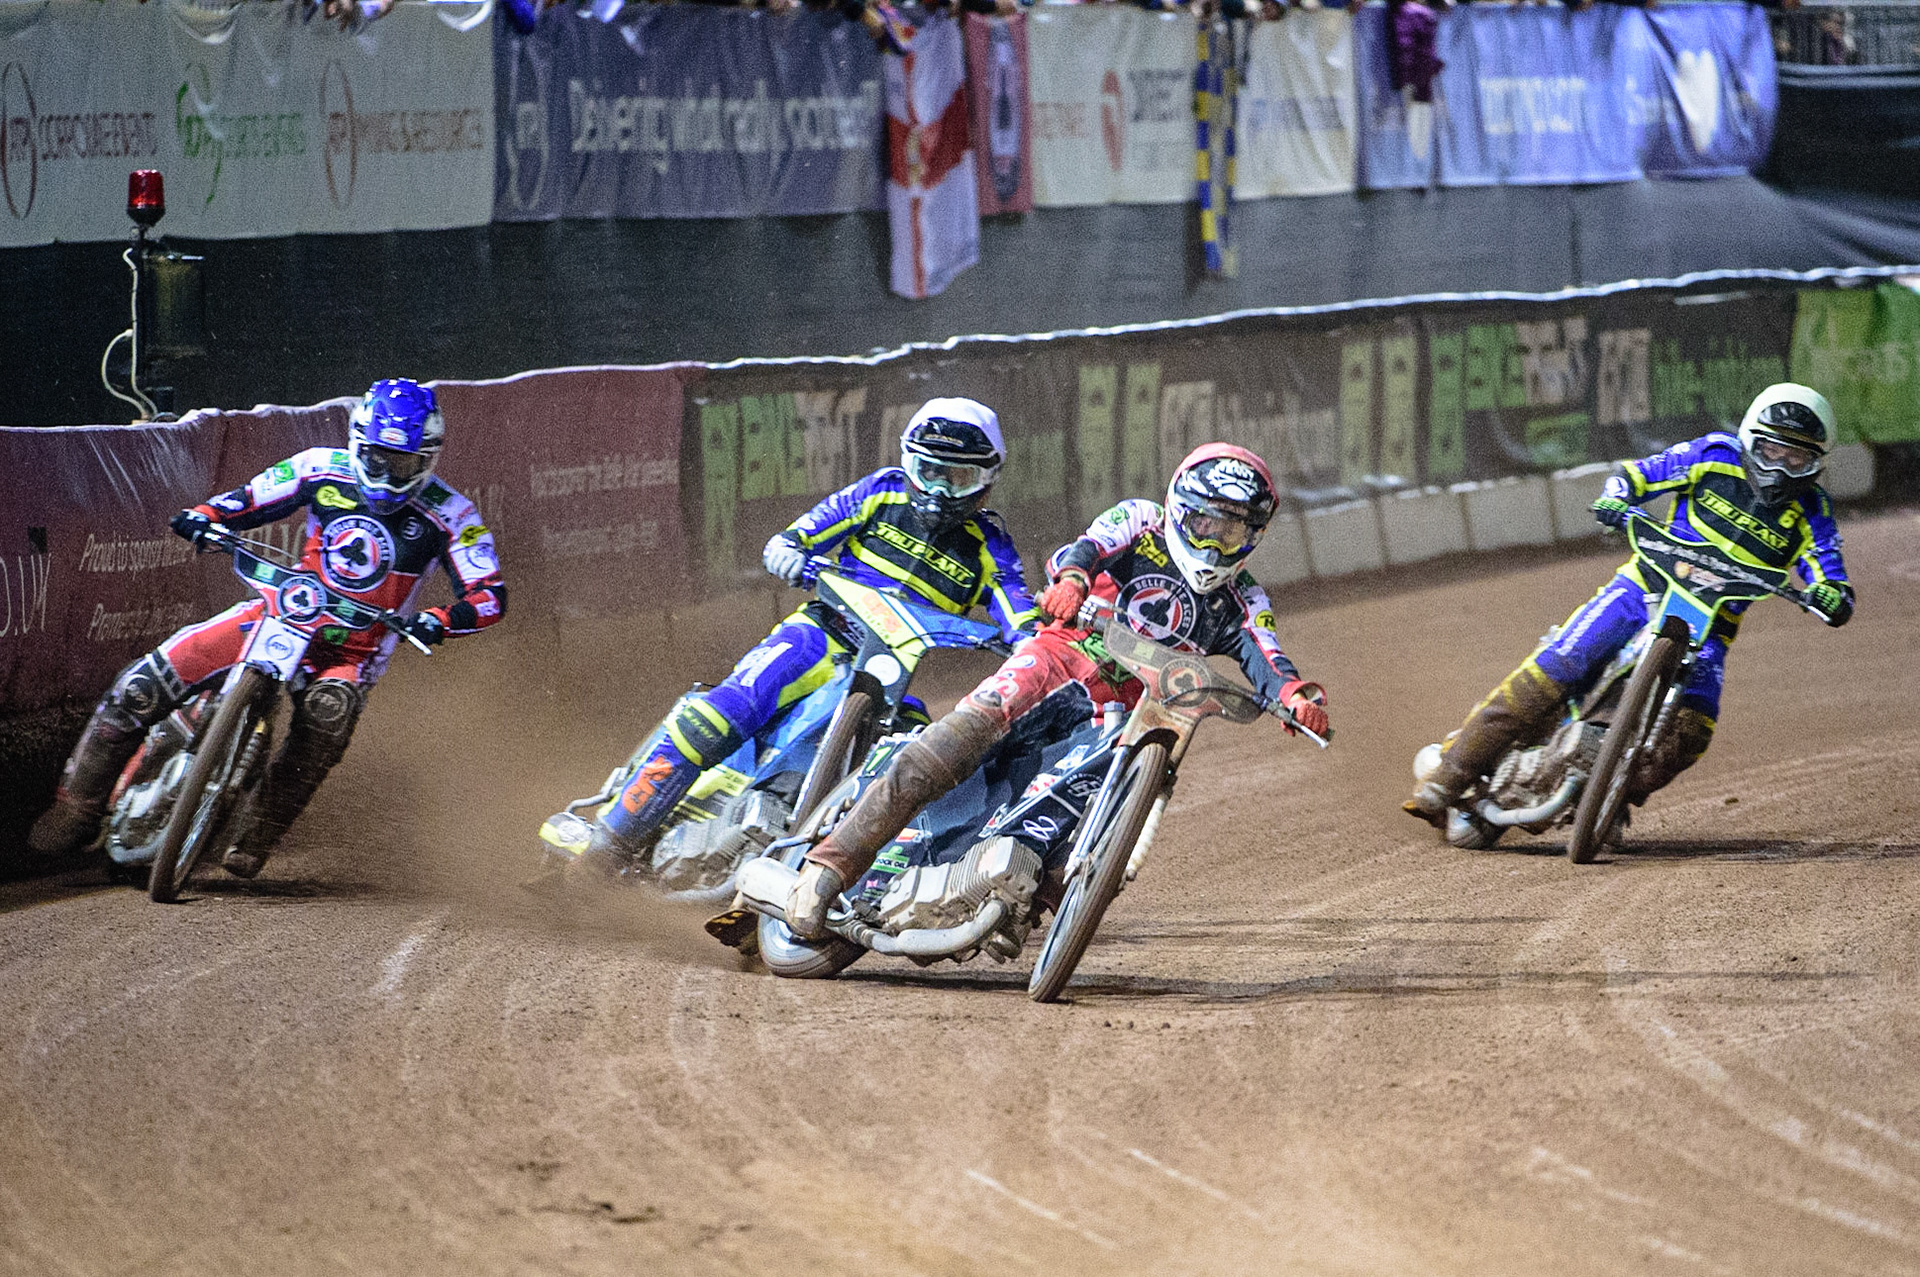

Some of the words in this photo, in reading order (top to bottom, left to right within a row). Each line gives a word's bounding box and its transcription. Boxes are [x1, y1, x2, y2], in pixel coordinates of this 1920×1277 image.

[1778, 509, 1797, 528] 6
[1134, 578, 1167, 591] BELLE
[1181, 603, 1193, 630] ACES
